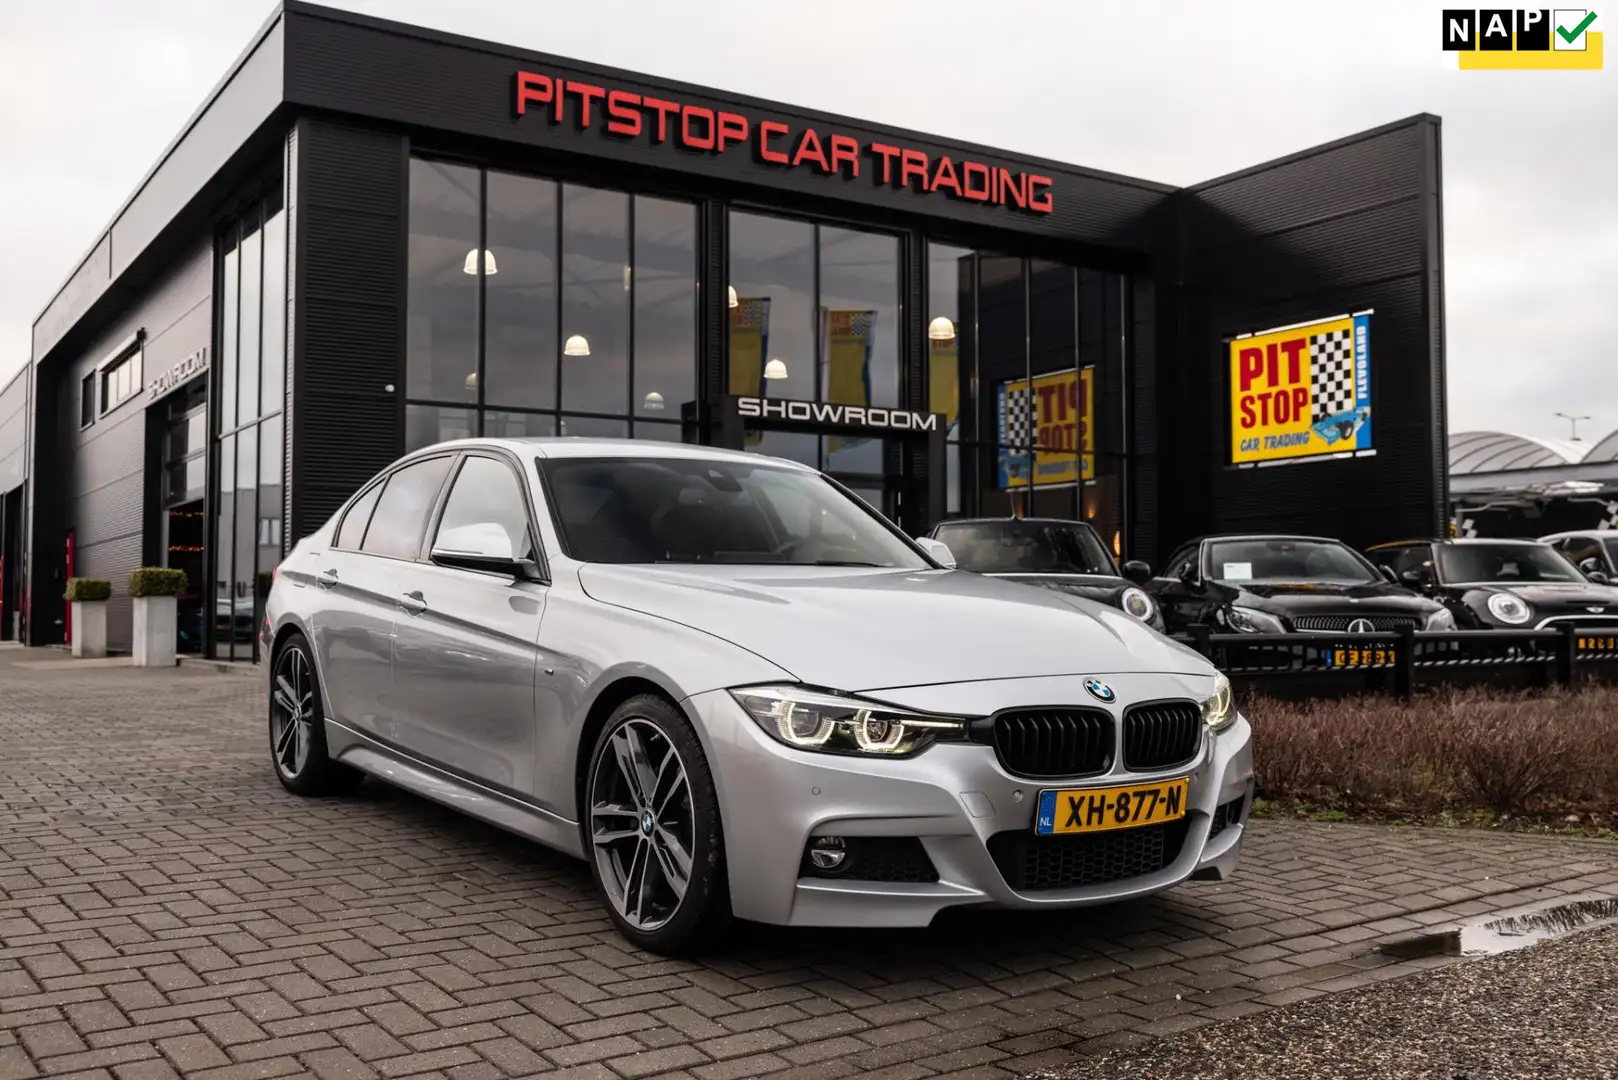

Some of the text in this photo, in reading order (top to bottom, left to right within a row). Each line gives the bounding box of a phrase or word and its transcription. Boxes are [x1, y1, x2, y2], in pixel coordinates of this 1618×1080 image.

[517, 71, 1053, 212] PITSTOP CAR TRADING
[1239, 338, 1307, 392] PIT
[738, 397, 936, 431] SHOWROOM
[1240, 387, 1309, 429] STOP
[1240, 431, 1310, 452] CAR TRADING
[1039, 817, 1051, 827] NL
[1065, 785, 1182, 828] XH-877-N
